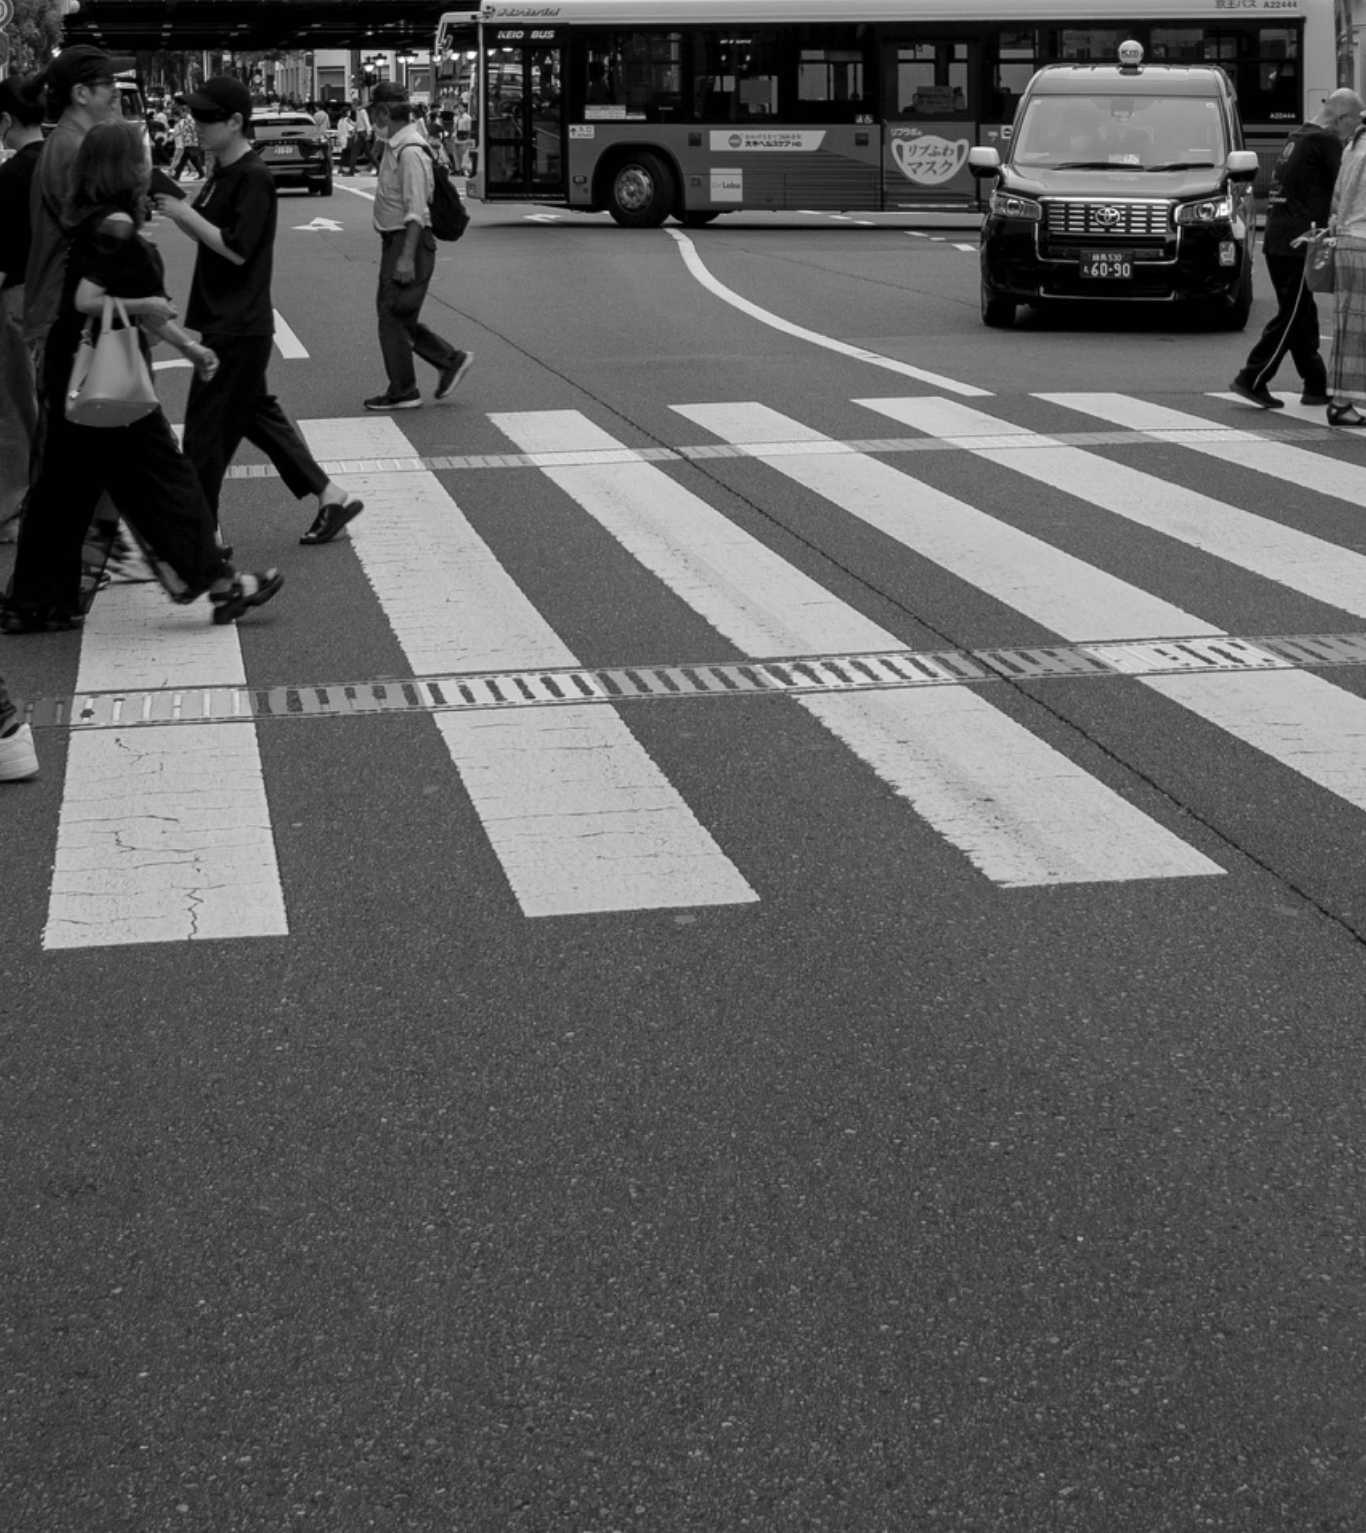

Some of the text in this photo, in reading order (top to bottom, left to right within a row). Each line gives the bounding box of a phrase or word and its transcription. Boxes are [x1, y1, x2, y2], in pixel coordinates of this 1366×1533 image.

[1214, 0, 1298, 9] 京王バス A22444
[497, 30, 555, 39] KEIO BUS
[908, 144, 955, 157] リブふわ
[908, 162, 954, 176] マスク
